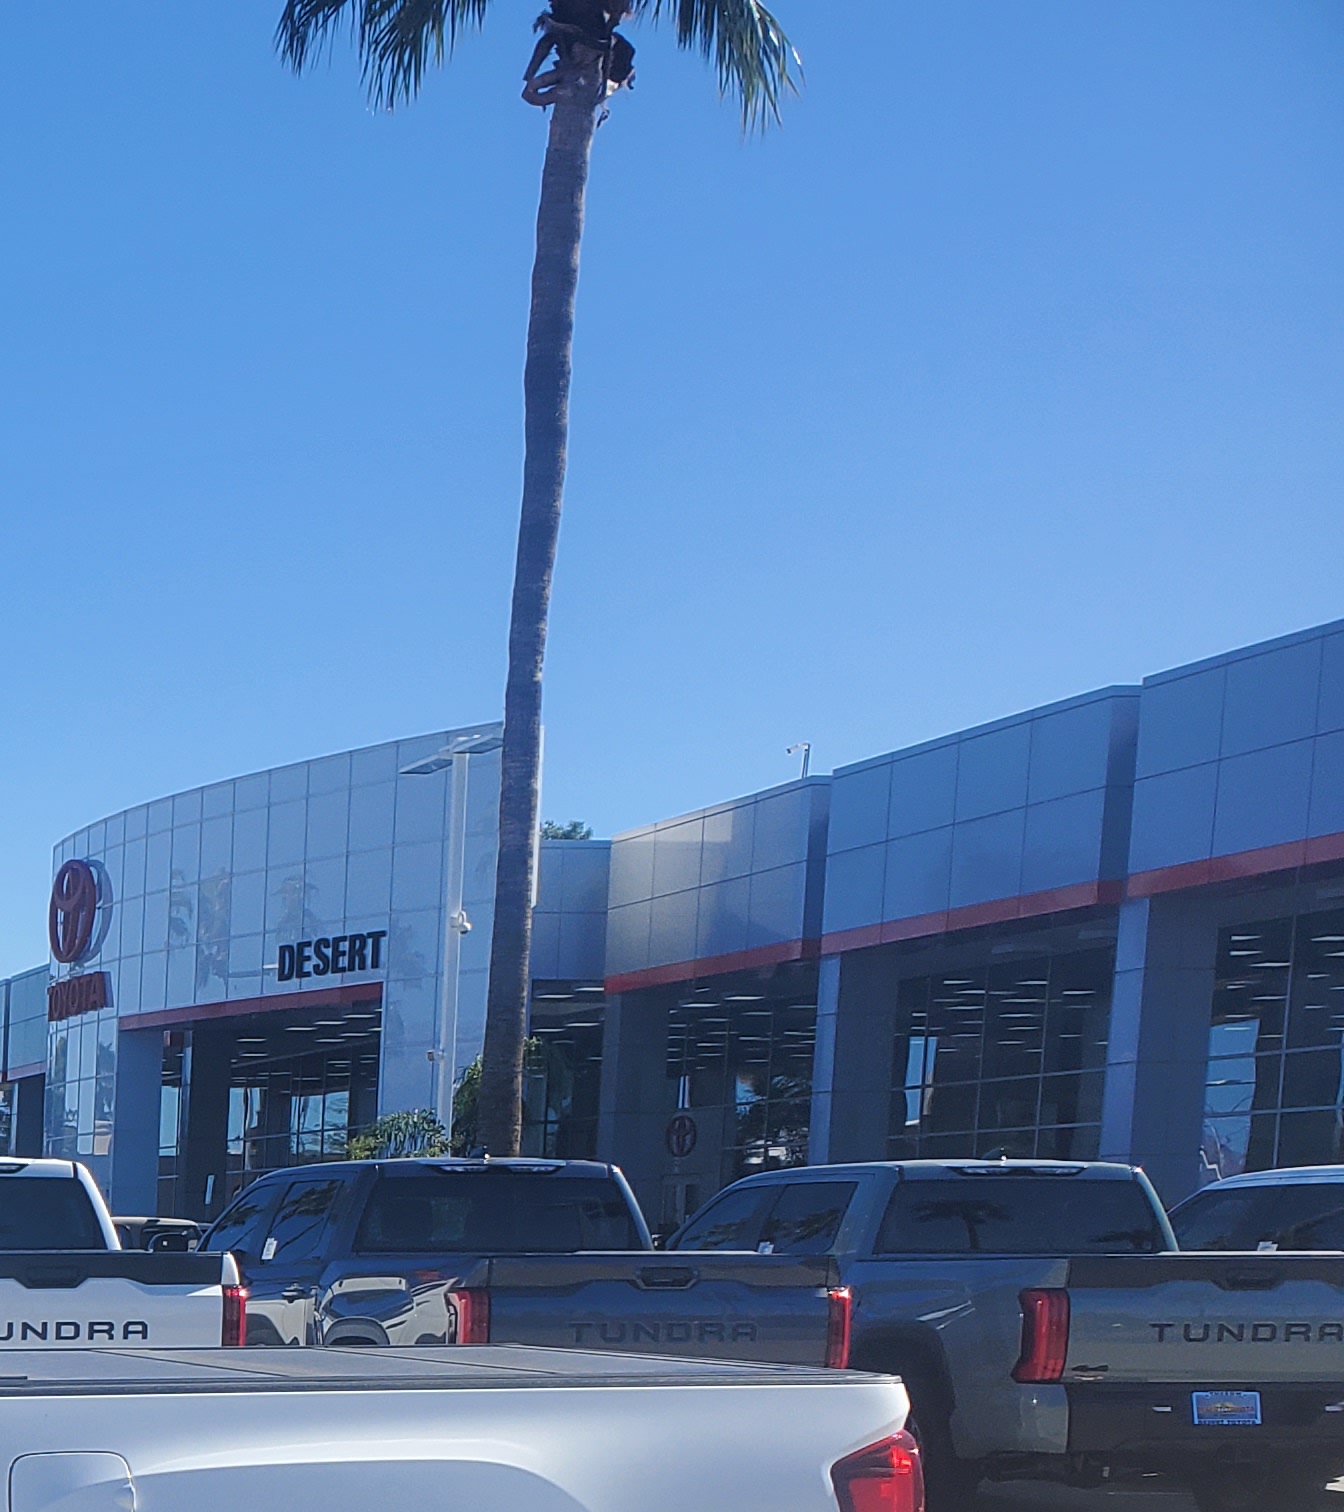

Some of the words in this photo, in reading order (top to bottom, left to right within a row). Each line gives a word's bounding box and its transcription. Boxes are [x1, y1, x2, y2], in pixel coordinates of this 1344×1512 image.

[277, 929, 387, 981] DESERT
[568, 1322, 757, 1342] TUNDRA
[1149, 1322, 1344, 1343] TUNDRA
